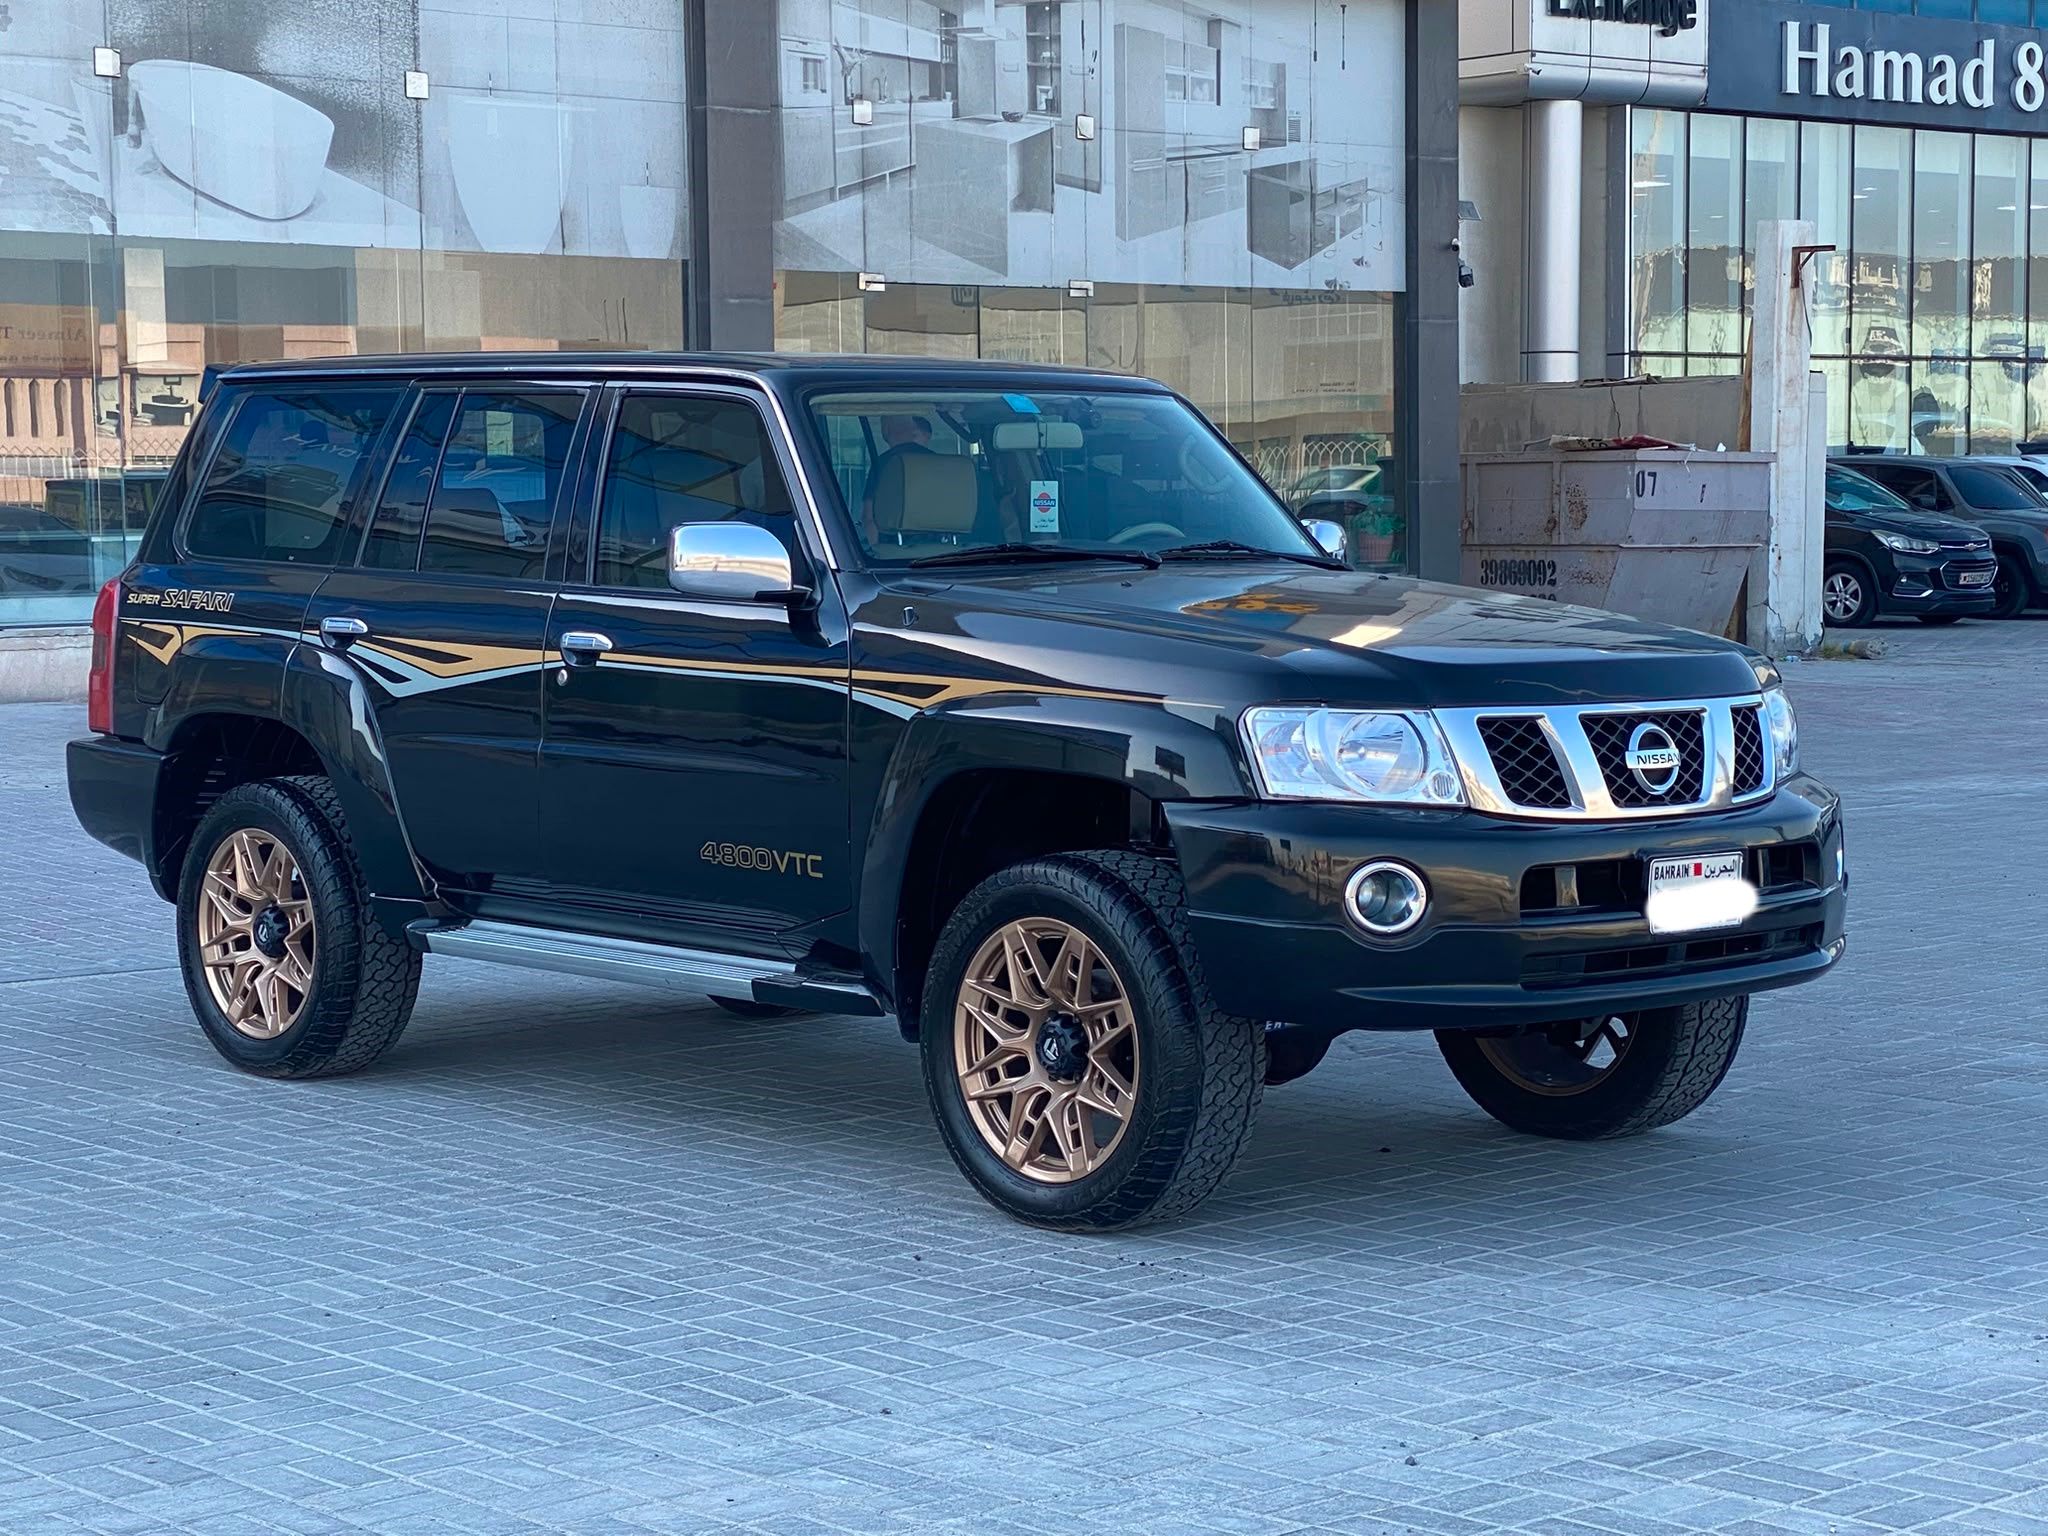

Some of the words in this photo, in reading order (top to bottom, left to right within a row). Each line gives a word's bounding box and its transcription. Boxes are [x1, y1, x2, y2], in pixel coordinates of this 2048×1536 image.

[1782, 20, 1995, 109] Hamad
[2011, 41, 2048, 113] 8
[1635, 469, 1658, 498] 07
[126, 593, 161, 605] SUPER
[161, 588, 235, 612] SAFARI
[1653, 863, 1690, 881] BAHRAIN
[1704, 858, 1737, 879] البحرين
